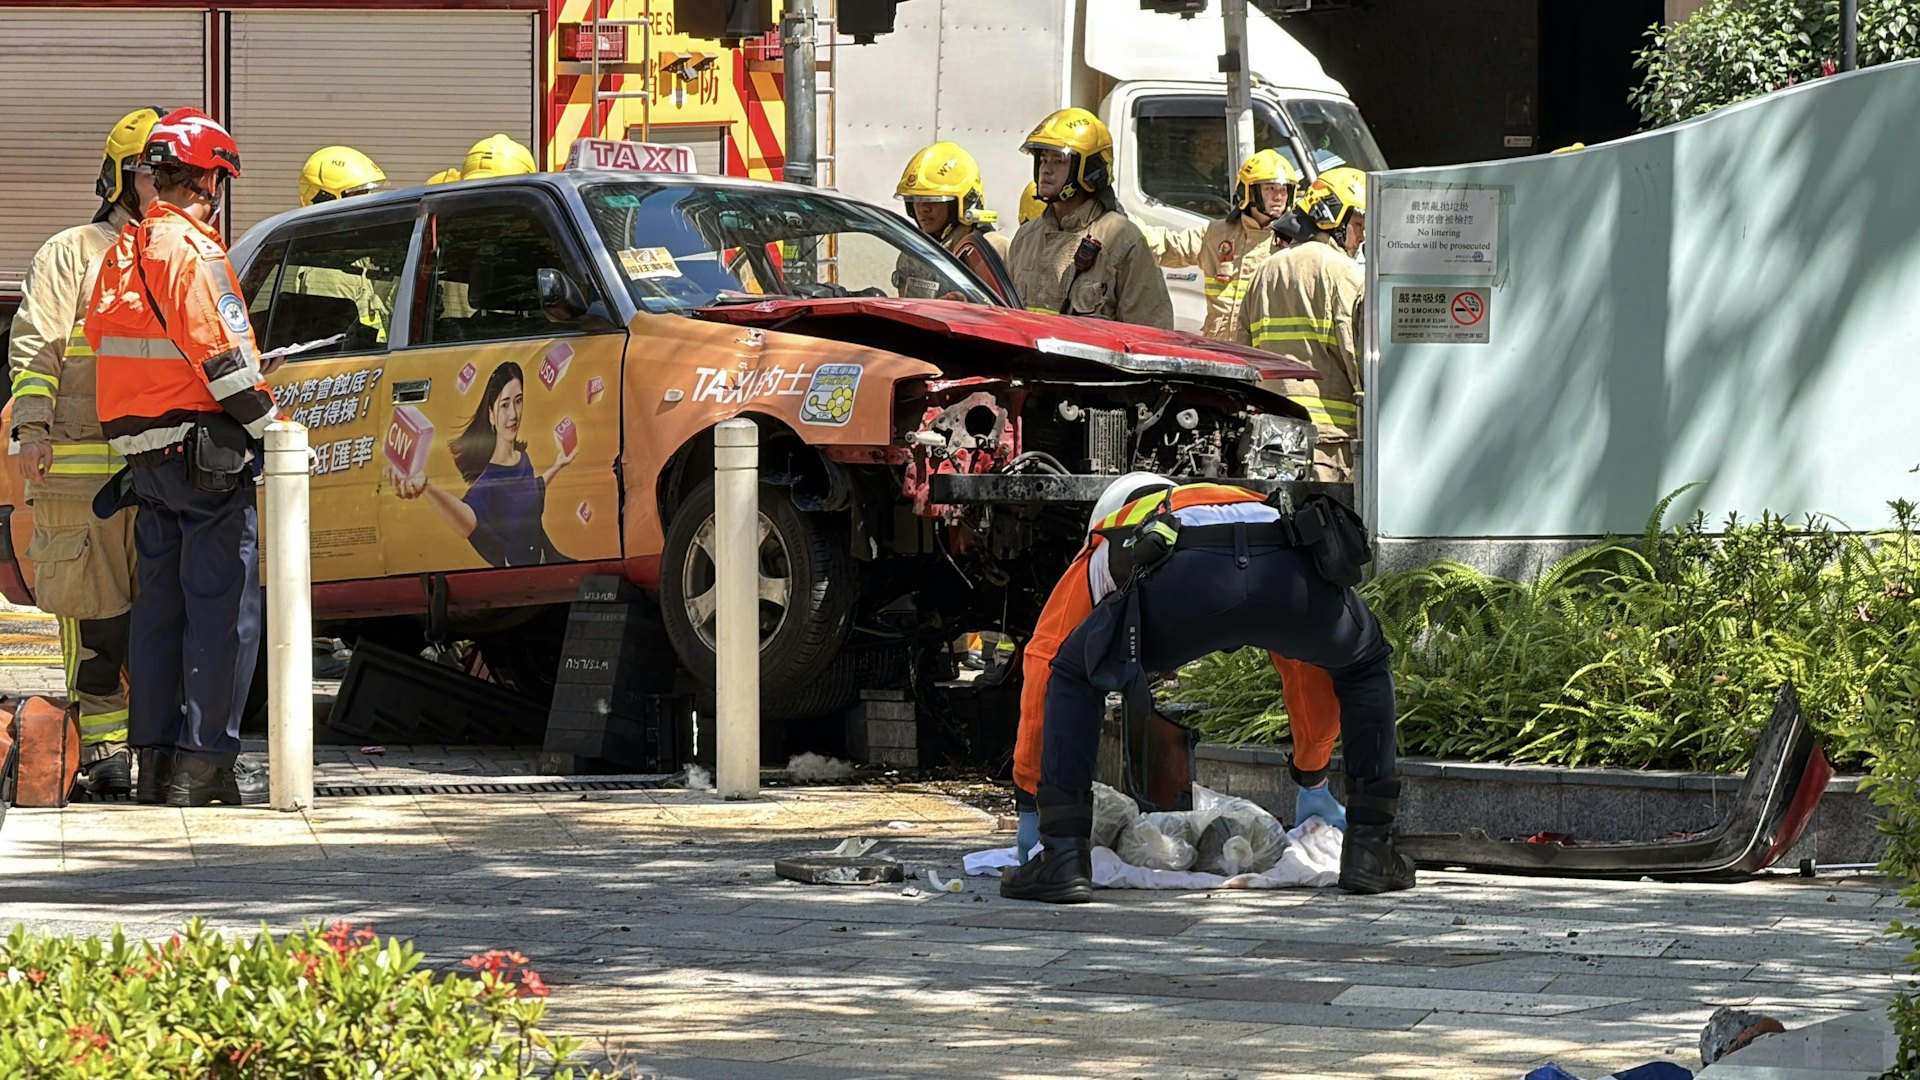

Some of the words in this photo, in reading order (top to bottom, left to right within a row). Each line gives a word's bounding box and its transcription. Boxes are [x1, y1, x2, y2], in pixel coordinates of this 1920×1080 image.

[638, 12, 662, 35] FRE
[1066, 118, 1090, 129] WTS
[590, 140, 688, 172] TAXI
[1411, 200, 1469, 212] 嚴禁亂拋垃圾
[1406, 214, 1474, 225] 違例者會被檢控
[1417, 228, 1429, 237] No
[1431, 228, 1461, 238] littering
[1387, 240, 1420, 249] Offender
[1422, 241, 1437, 249] will
[1439, 241, 1448, 249] be
[1450, 242, 1490, 251] prosecuted
[1398, 293, 1446, 304] 嚴禁吸煙
[540, 360, 555, 385] USD
[556, 418, 571, 434] CAD
[388, 422, 412, 460] CNY
[565, 658, 609, 671] WTS/LRU
